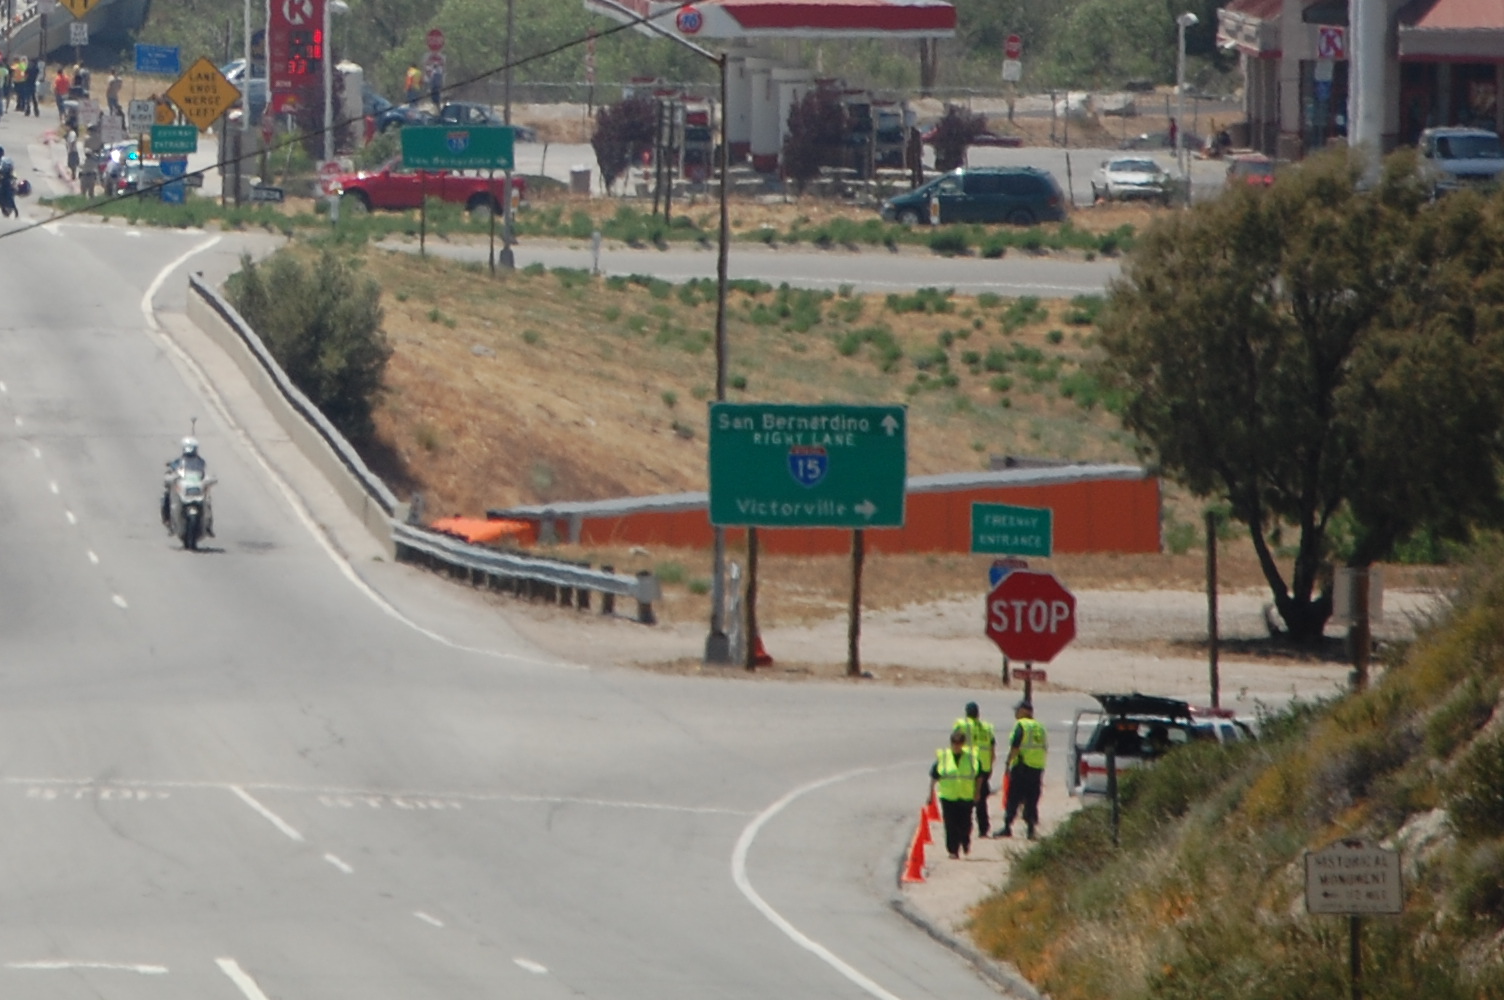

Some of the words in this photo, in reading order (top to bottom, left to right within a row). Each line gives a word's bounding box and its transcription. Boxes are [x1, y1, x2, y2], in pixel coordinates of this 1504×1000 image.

[189, 72, 216, 81] LANE
[190, 85, 217, 94] ENDS
[184, 96, 220, 105] MERGE
[189, 108, 215, 117] LEFT
[718, 413, 754, 430] San
[762, 413, 870, 432] Bernardino
[752, 432, 804, 446] RIGHT
[812, 433, 856, 447] LANE
[797, 458, 822, 479] 15
[737, 498, 847, 517] Victorville
[984, 514, 1039, 529] FREEWAY
[979, 533, 1043, 548] ENTRANCE
[990, 599, 1070, 634] STOP
[1319, 871, 1386, 886] MONUMENT
